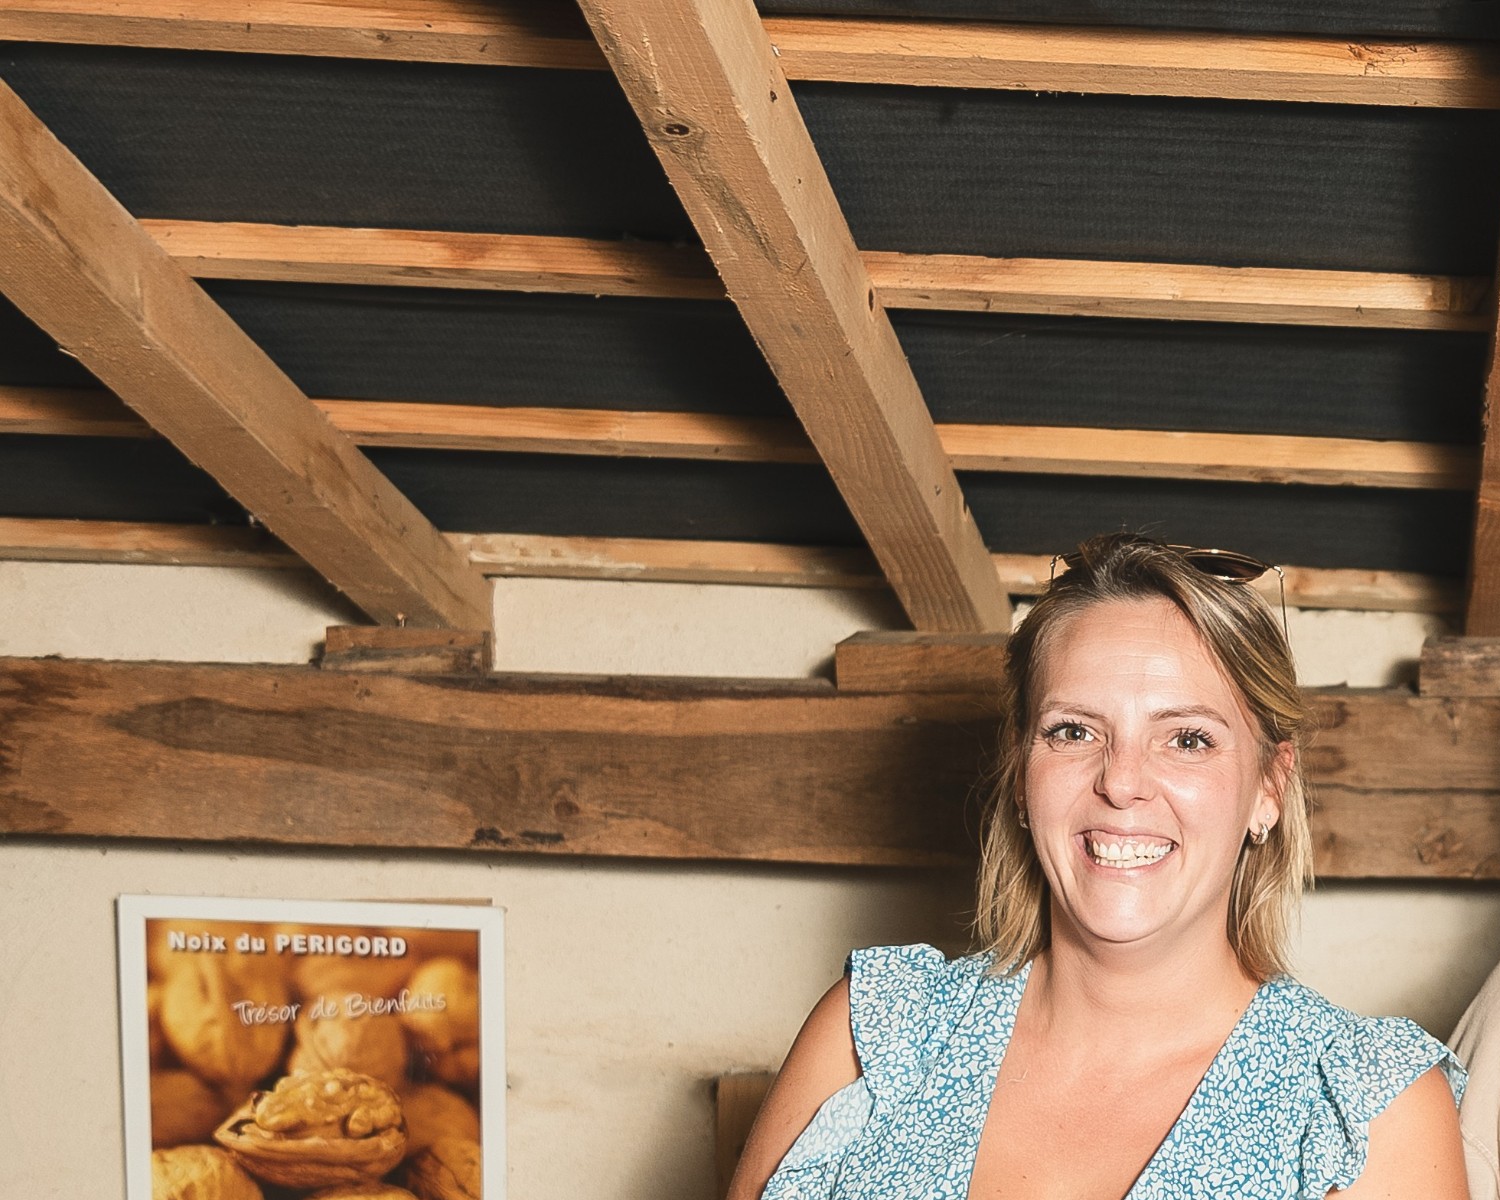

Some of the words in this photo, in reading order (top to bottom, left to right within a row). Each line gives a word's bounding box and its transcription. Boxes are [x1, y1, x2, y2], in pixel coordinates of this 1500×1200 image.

[168, 930, 227, 951] Noix
[234, 933, 266, 952] du
[274, 934, 408, 957] PERIGORD
[232, 999, 301, 1025] Trésor
[310, 996, 340, 1019] de
[344, 989, 448, 1018] Bienfaits
